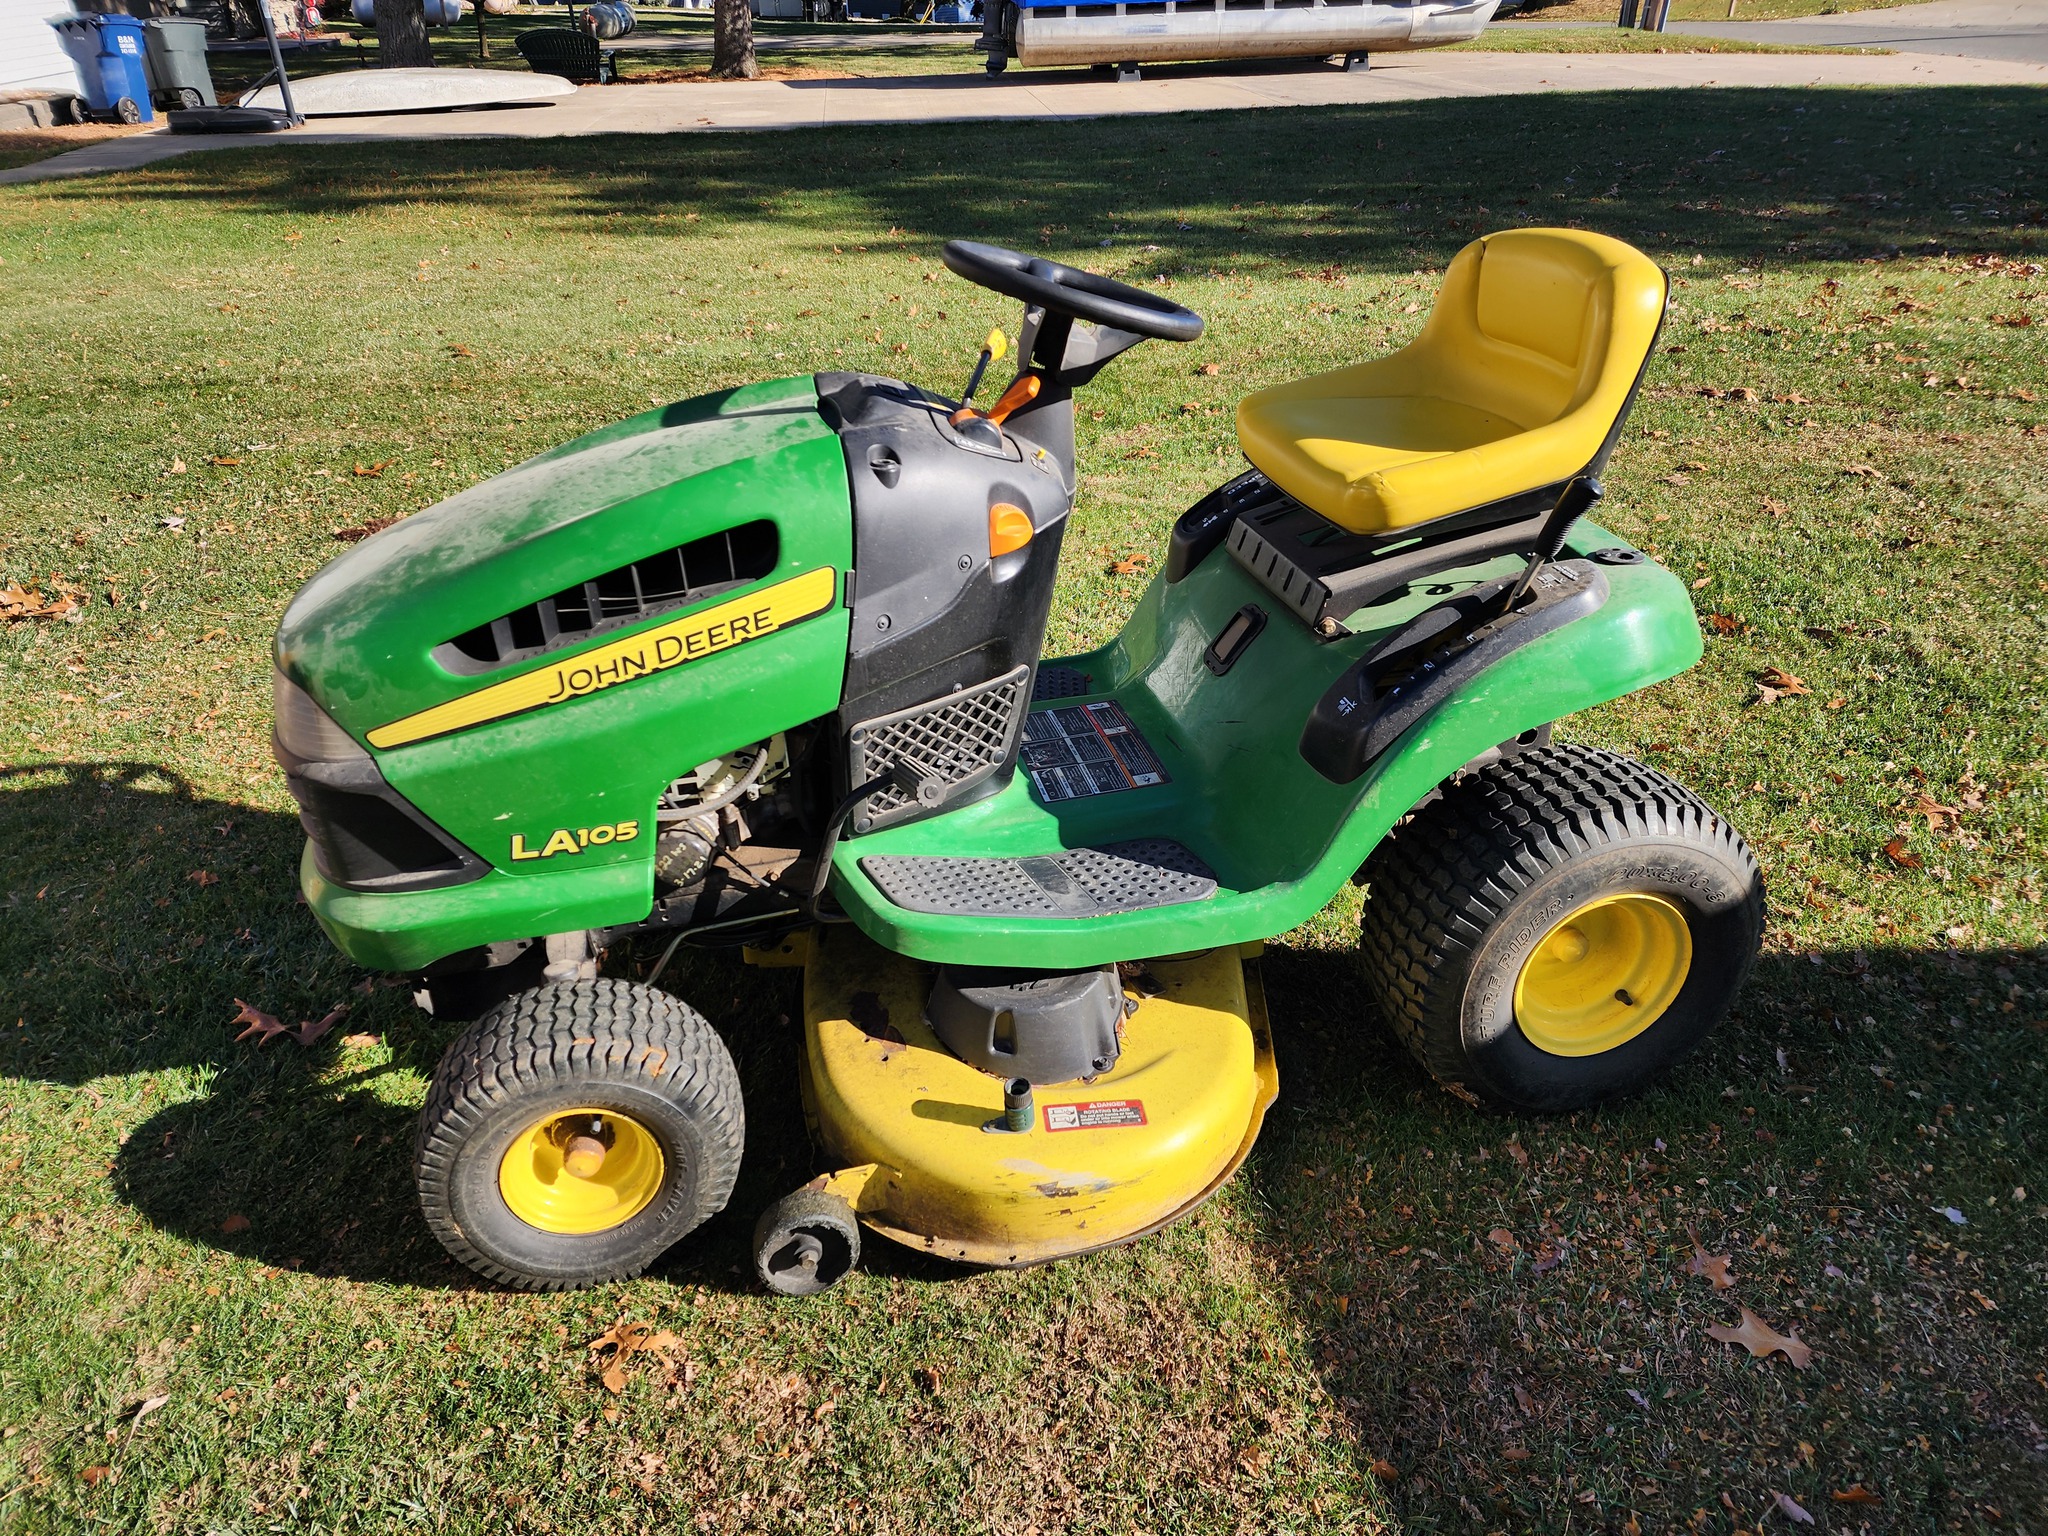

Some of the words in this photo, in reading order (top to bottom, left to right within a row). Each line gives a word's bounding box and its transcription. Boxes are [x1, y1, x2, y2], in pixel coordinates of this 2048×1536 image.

[549, 650, 646, 699] JOHN
[656, 607, 773, 665] DEERE
[511, 820, 639, 862] LA105
[1479, 975, 1506, 1040] TURF
[1497, 898, 1564, 971] RIDER
